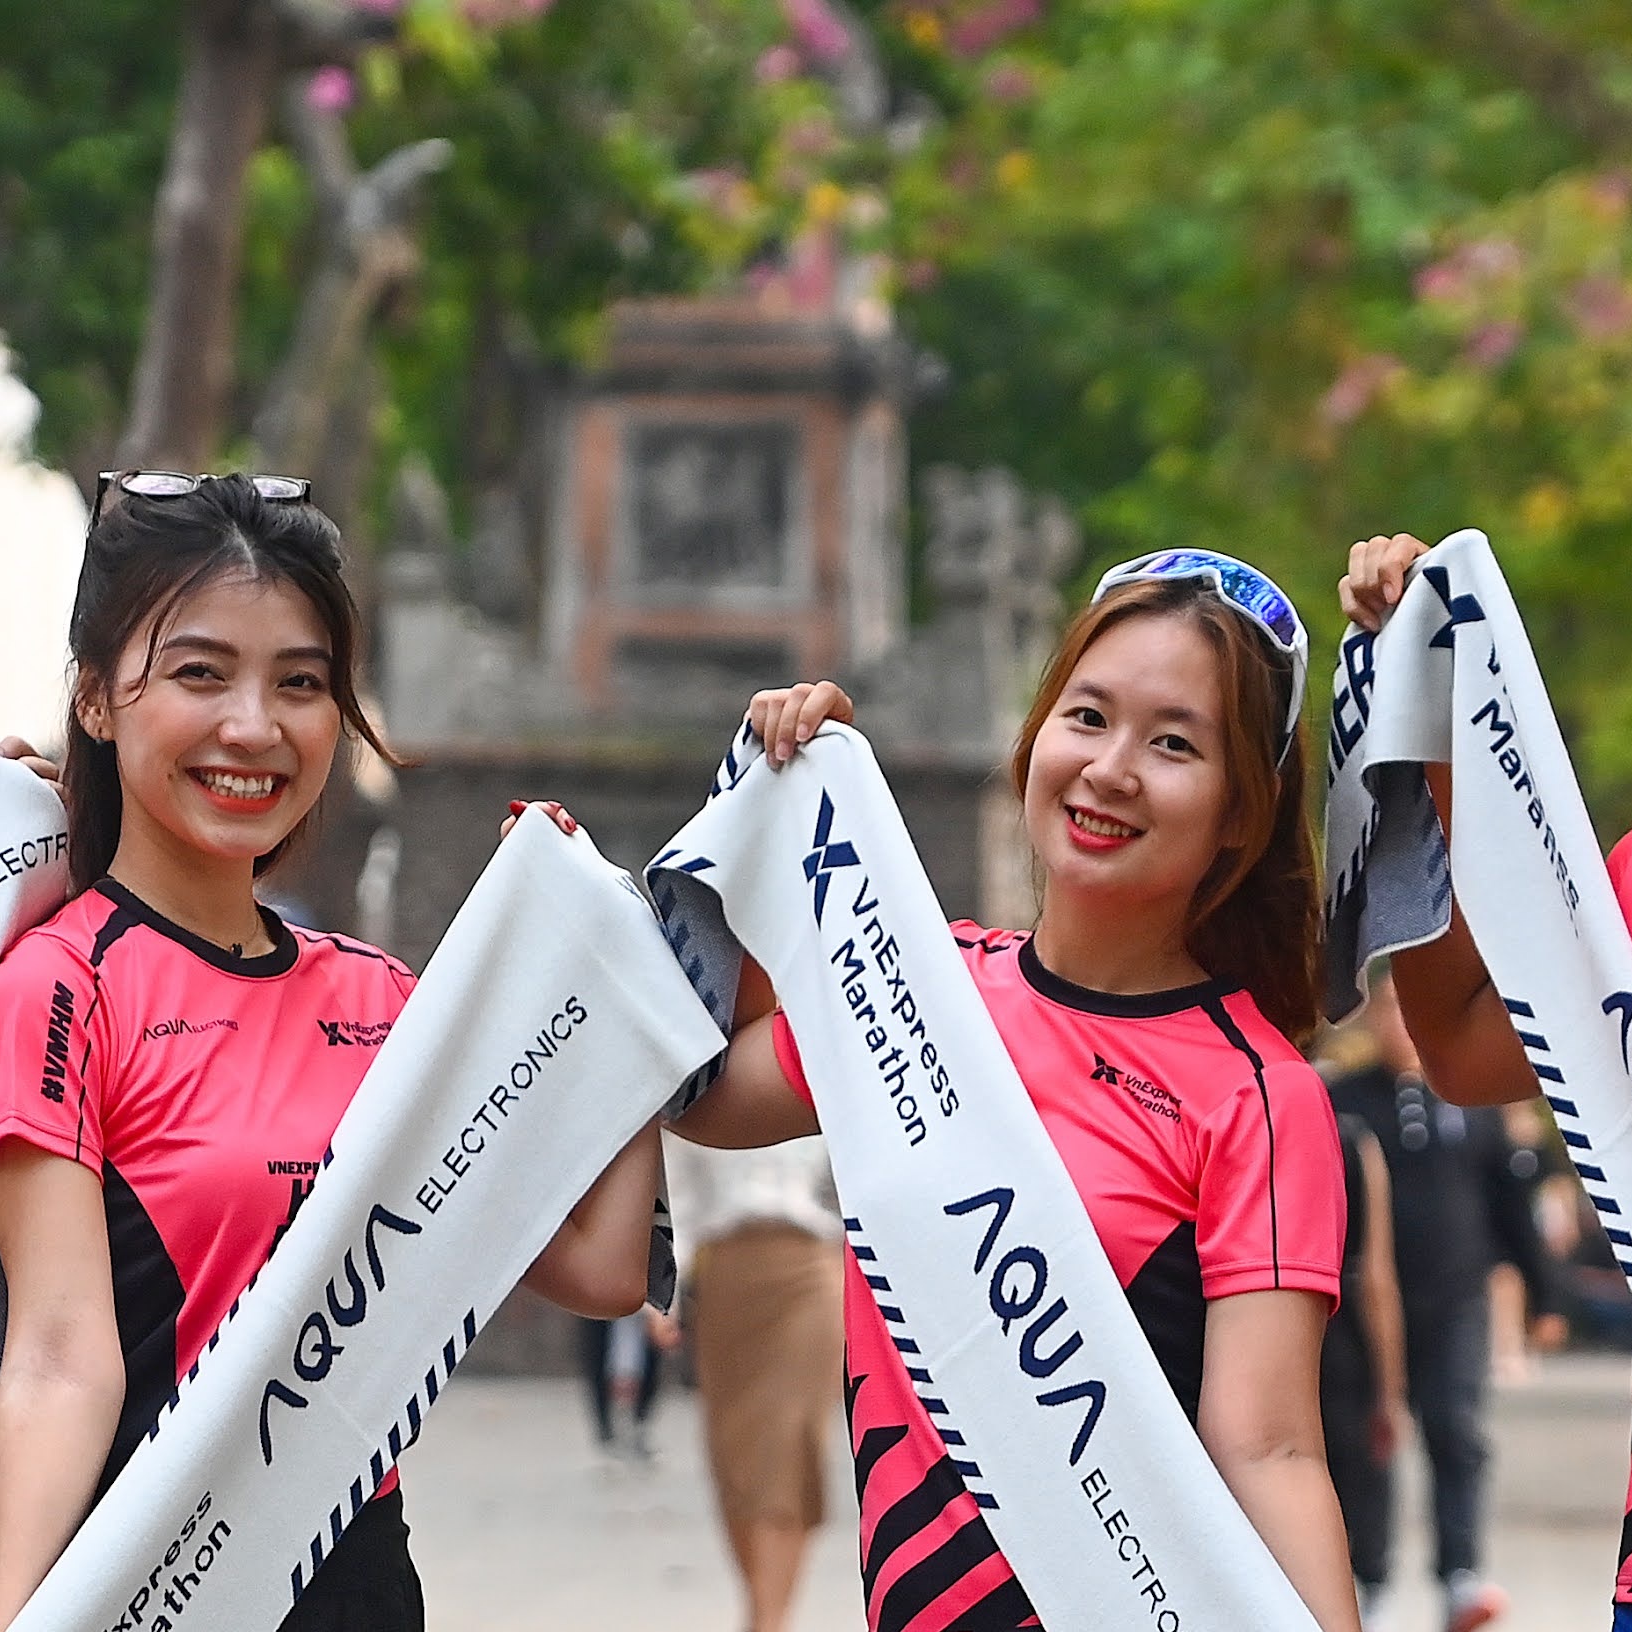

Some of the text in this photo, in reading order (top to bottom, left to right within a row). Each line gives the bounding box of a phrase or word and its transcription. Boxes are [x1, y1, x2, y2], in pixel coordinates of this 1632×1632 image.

[40, 979, 75, 1104] #VMHM
[143, 1018, 193, 1041] AQUA
[830, 938, 926, 1147] Marathon
[852, 874, 959, 1117] VnExpress
[260, 996, 588, 1466] AQUA ELECTRONICS
[945, 1186, 1106, 1467] AQUA
